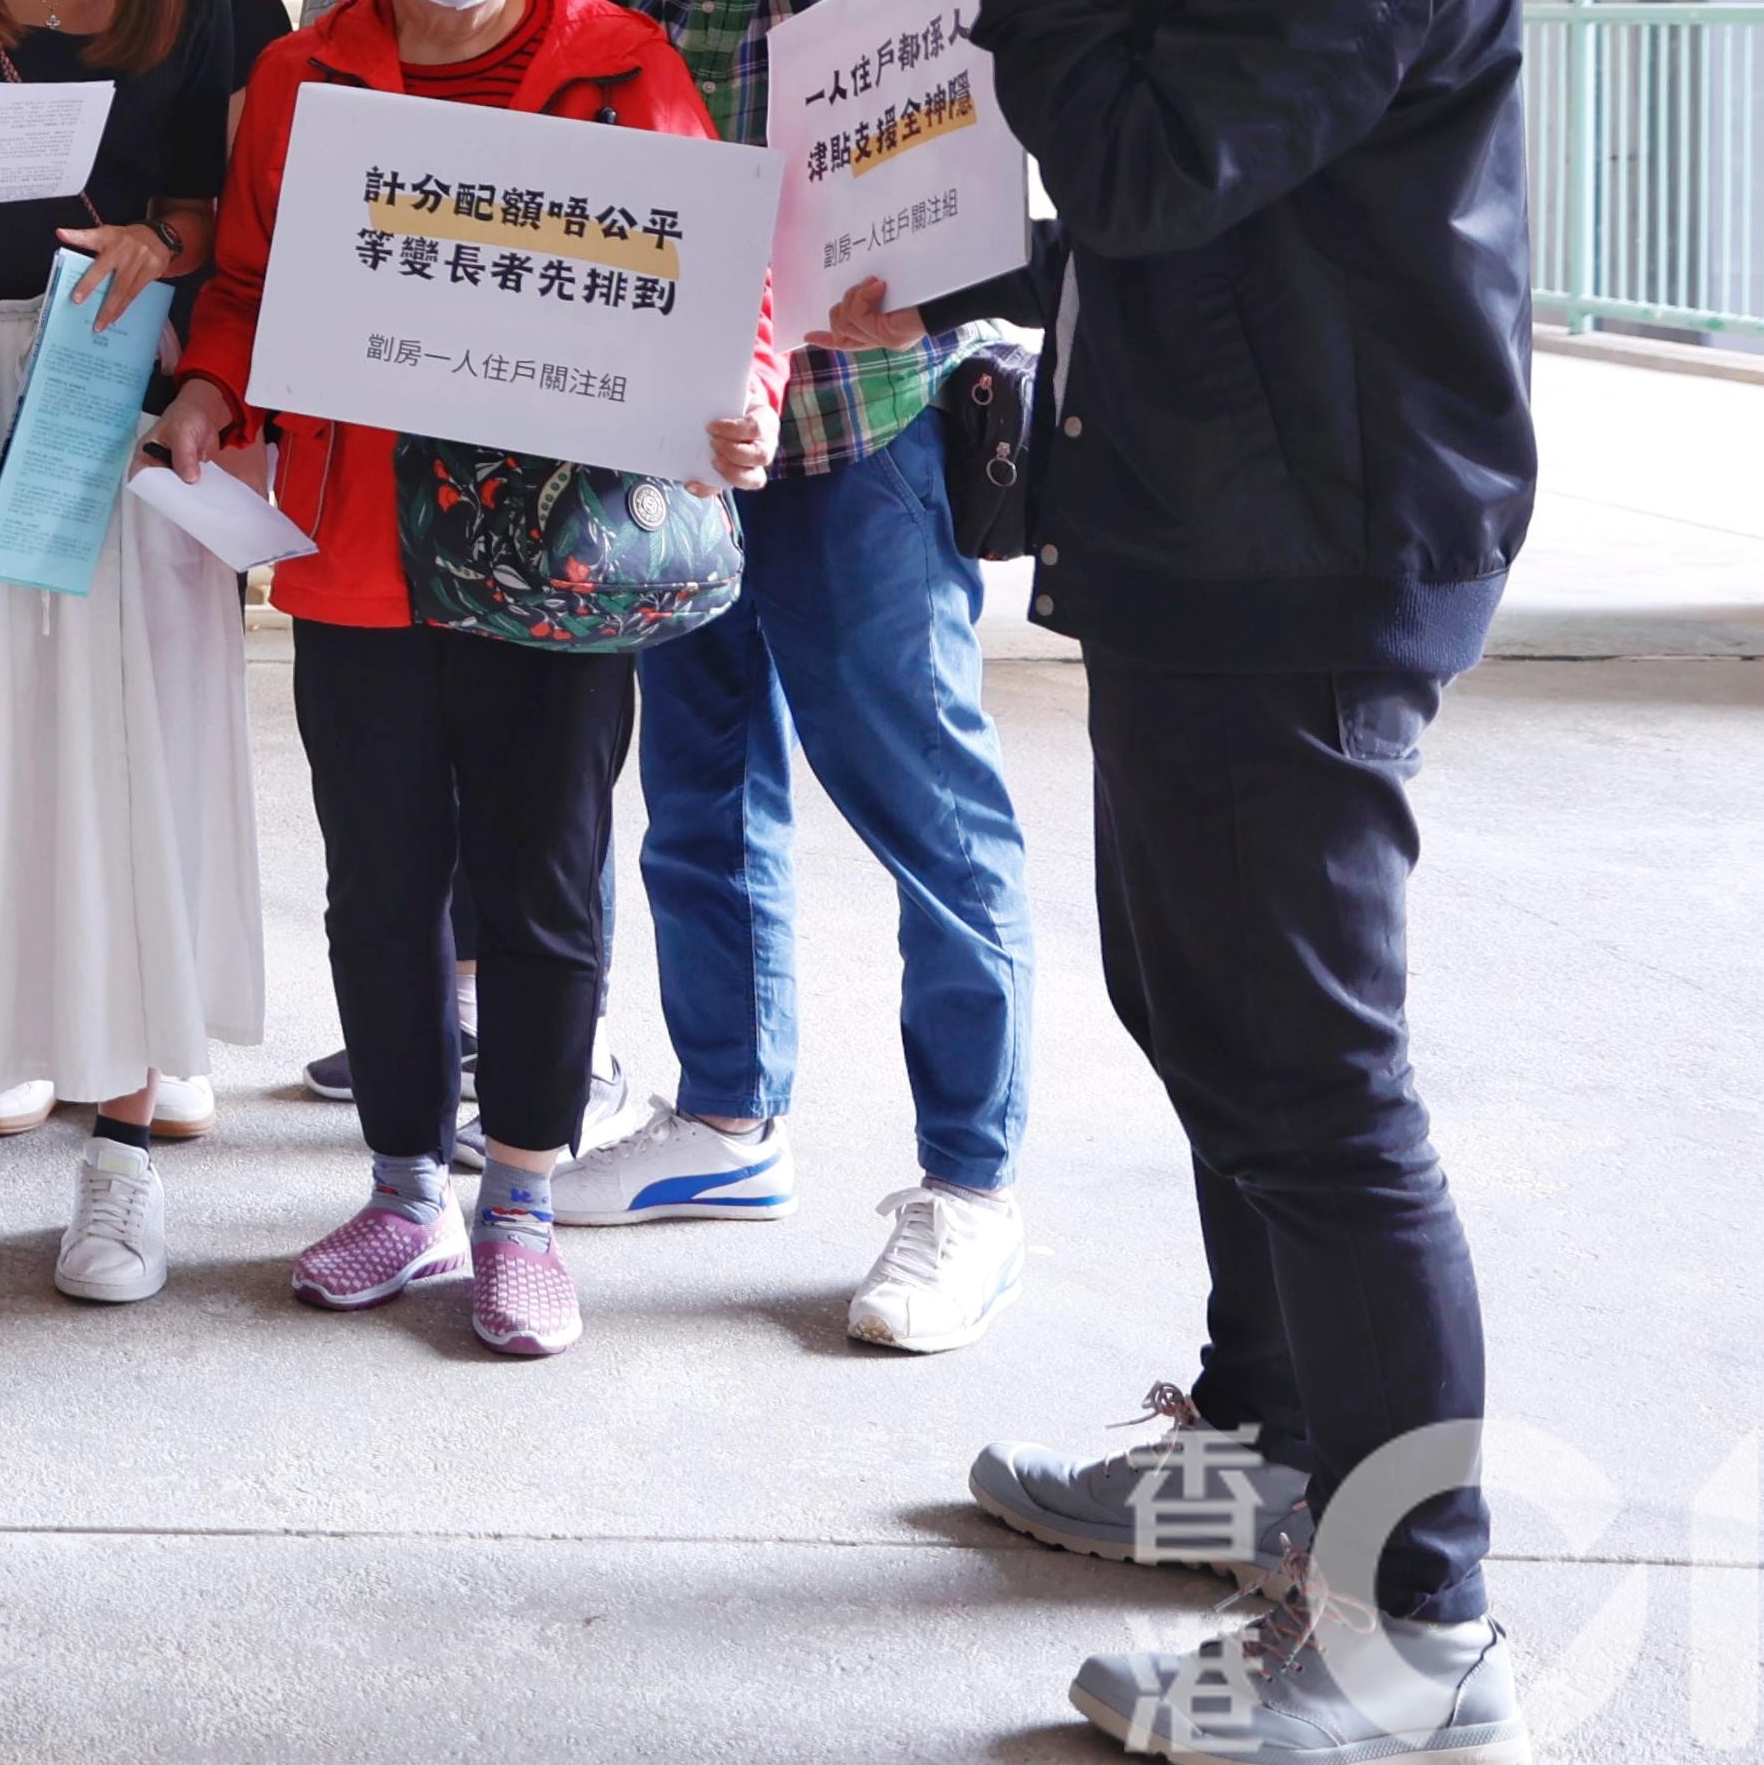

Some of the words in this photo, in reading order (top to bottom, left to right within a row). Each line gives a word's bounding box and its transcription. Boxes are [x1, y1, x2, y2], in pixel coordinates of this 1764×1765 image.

[805, 8, 971, 107] 一人住戶都係人
[807, 69, 973, 183] 津貼支援全神隱
[363, 165, 683, 251] 計分配額唔公平
[823, 188, 959, 269] 劏房一人住戶關注組
[355, 228, 677, 316] 等變長者先排到
[366, 333, 628, 403] 劏房一人住戶關注組
